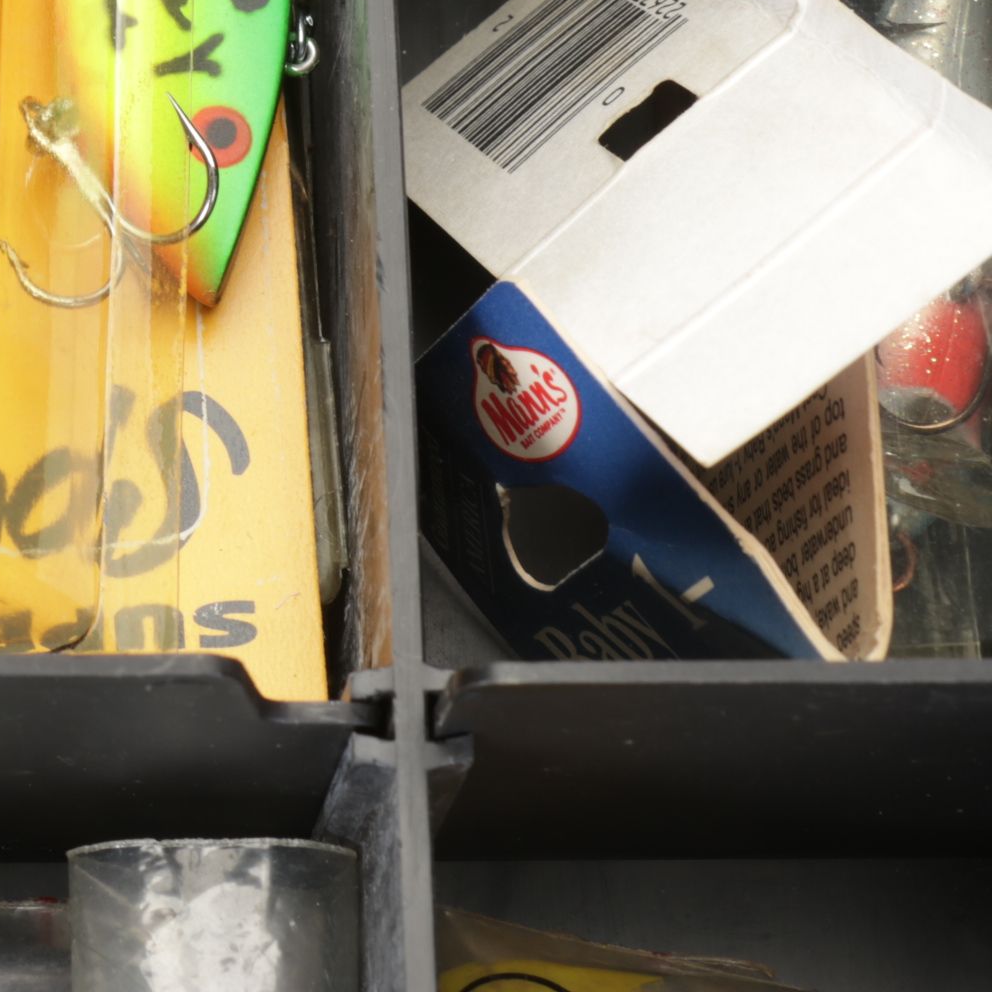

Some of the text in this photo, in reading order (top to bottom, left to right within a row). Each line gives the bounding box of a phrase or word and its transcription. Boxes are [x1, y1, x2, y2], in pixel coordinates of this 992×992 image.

[481, 364, 568, 446] Mann's
[824, 397, 846, 426] top
[520, 411, 564, 450] BAIT COMPANY
[791, 426, 808, 454] the
[810, 415, 821, 445] of
[766, 444, 790, 480] water
[794, 446, 823, 490] grass
[824, 433, 847, 472] and
[736, 478, 751, 507] any
[754, 467, 764, 491] or
[772, 477, 796, 512] beds
[823, 469, 851, 510] ideal
[753, 498, 772, 527] that
[809, 494, 822, 520] for
[776, 508, 808, 547] fishing
[801, 505, 853, 566] underwater
[820, 563, 830, 590] at
[831, 541, 856, 577] deep
[812, 572, 819, 594] a
[842, 578, 858, 615] and
